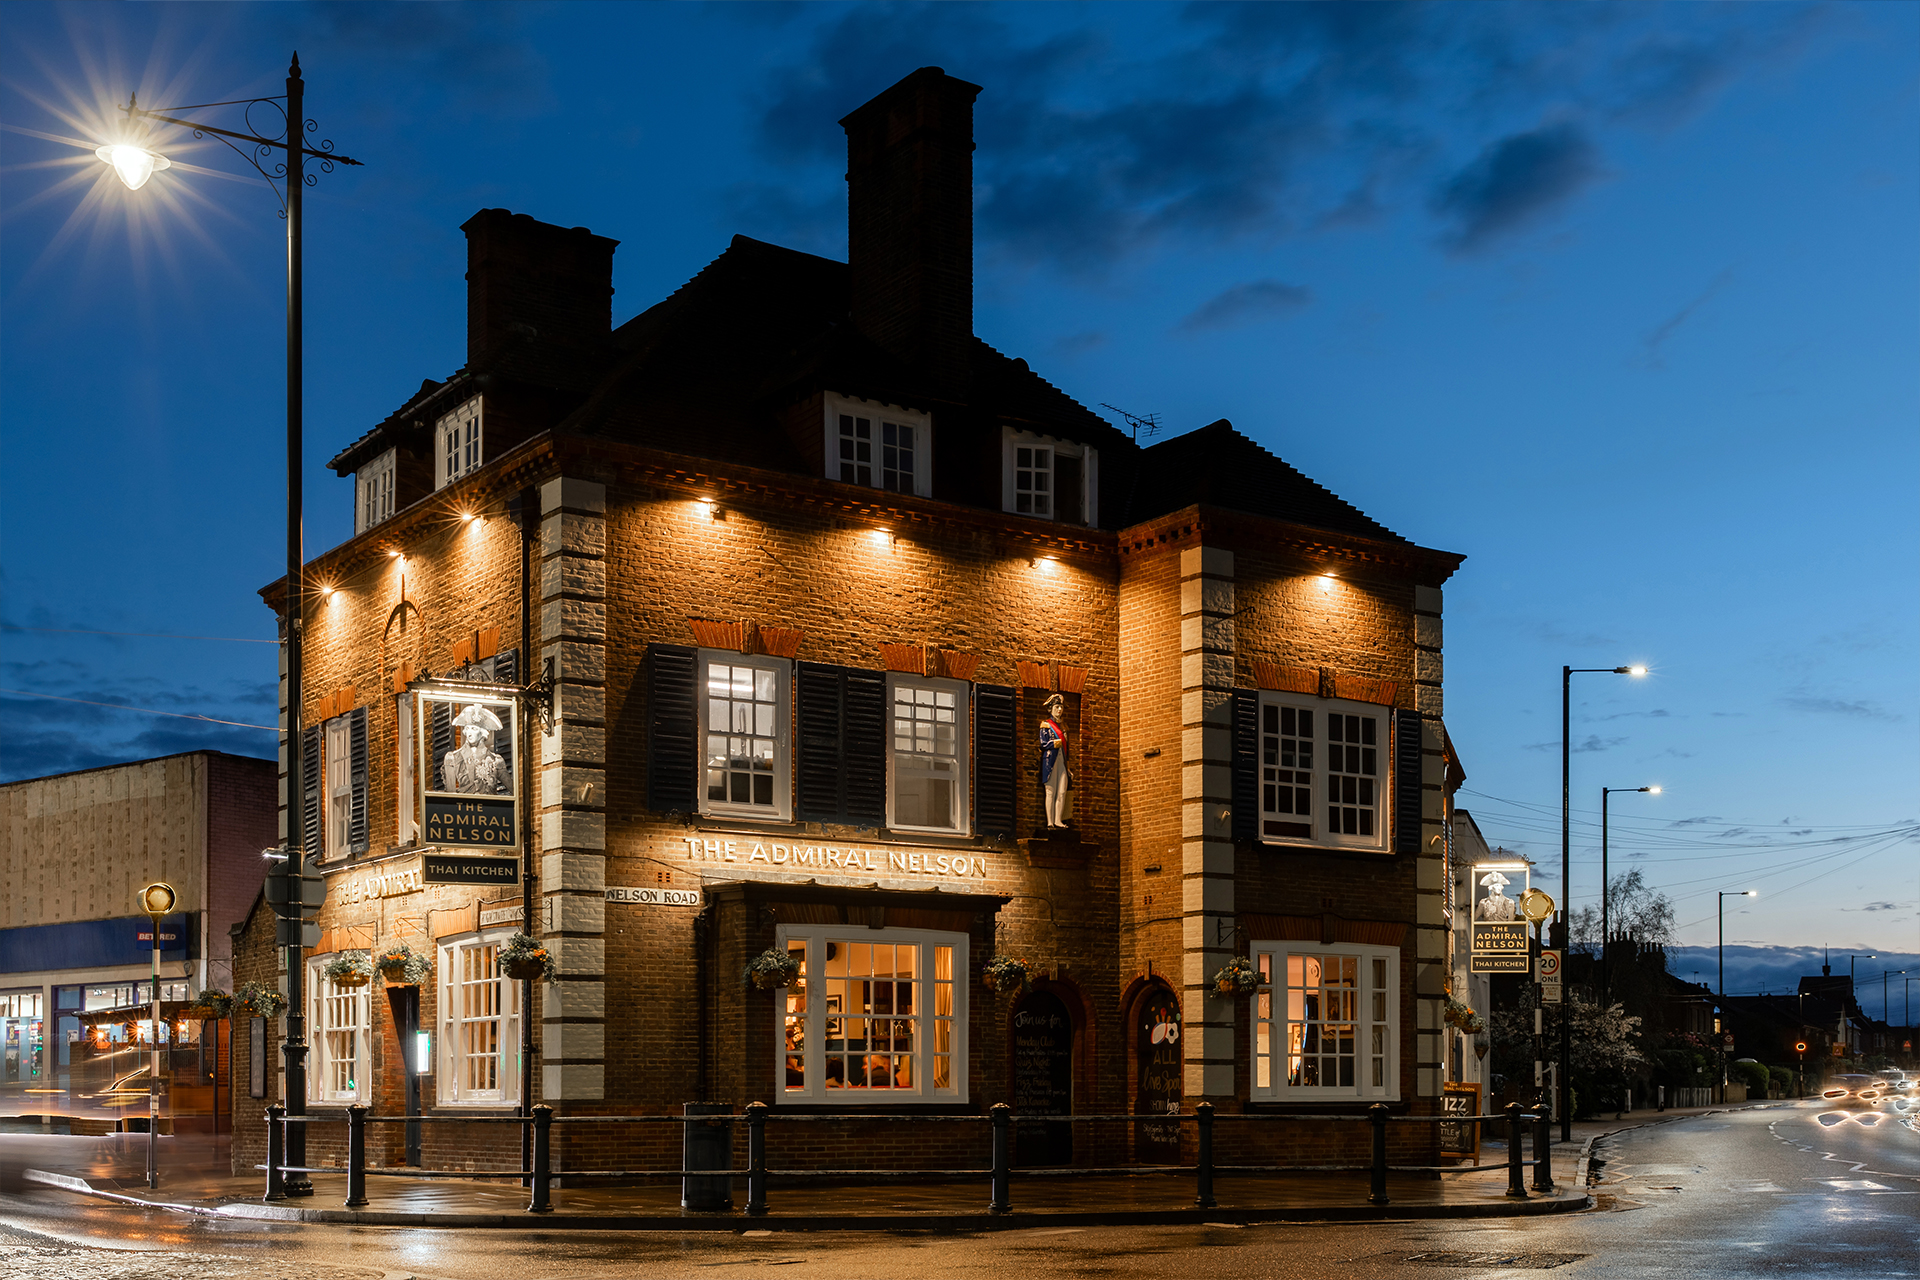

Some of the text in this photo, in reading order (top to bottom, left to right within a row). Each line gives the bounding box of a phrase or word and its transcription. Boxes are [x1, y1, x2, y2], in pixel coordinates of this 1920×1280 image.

[456, 802, 483, 812] THE
[430, 813, 510, 827] ADMIRAL
[430, 827, 510, 842] NELSON
[684, 838, 986, 878] THE ADMIRAL NELSON
[429, 865, 513, 876] THAI KITCHEN
[337, 882, 359, 905] THE
[606, 889, 698, 904] NELSON ROAD
[1476, 940, 1524, 948] NELSON
[1541, 958, 1556, 968] 20
[1153, 1049, 1177, 1065] ALL
[1440, 1097, 1467, 1112] IZZ
